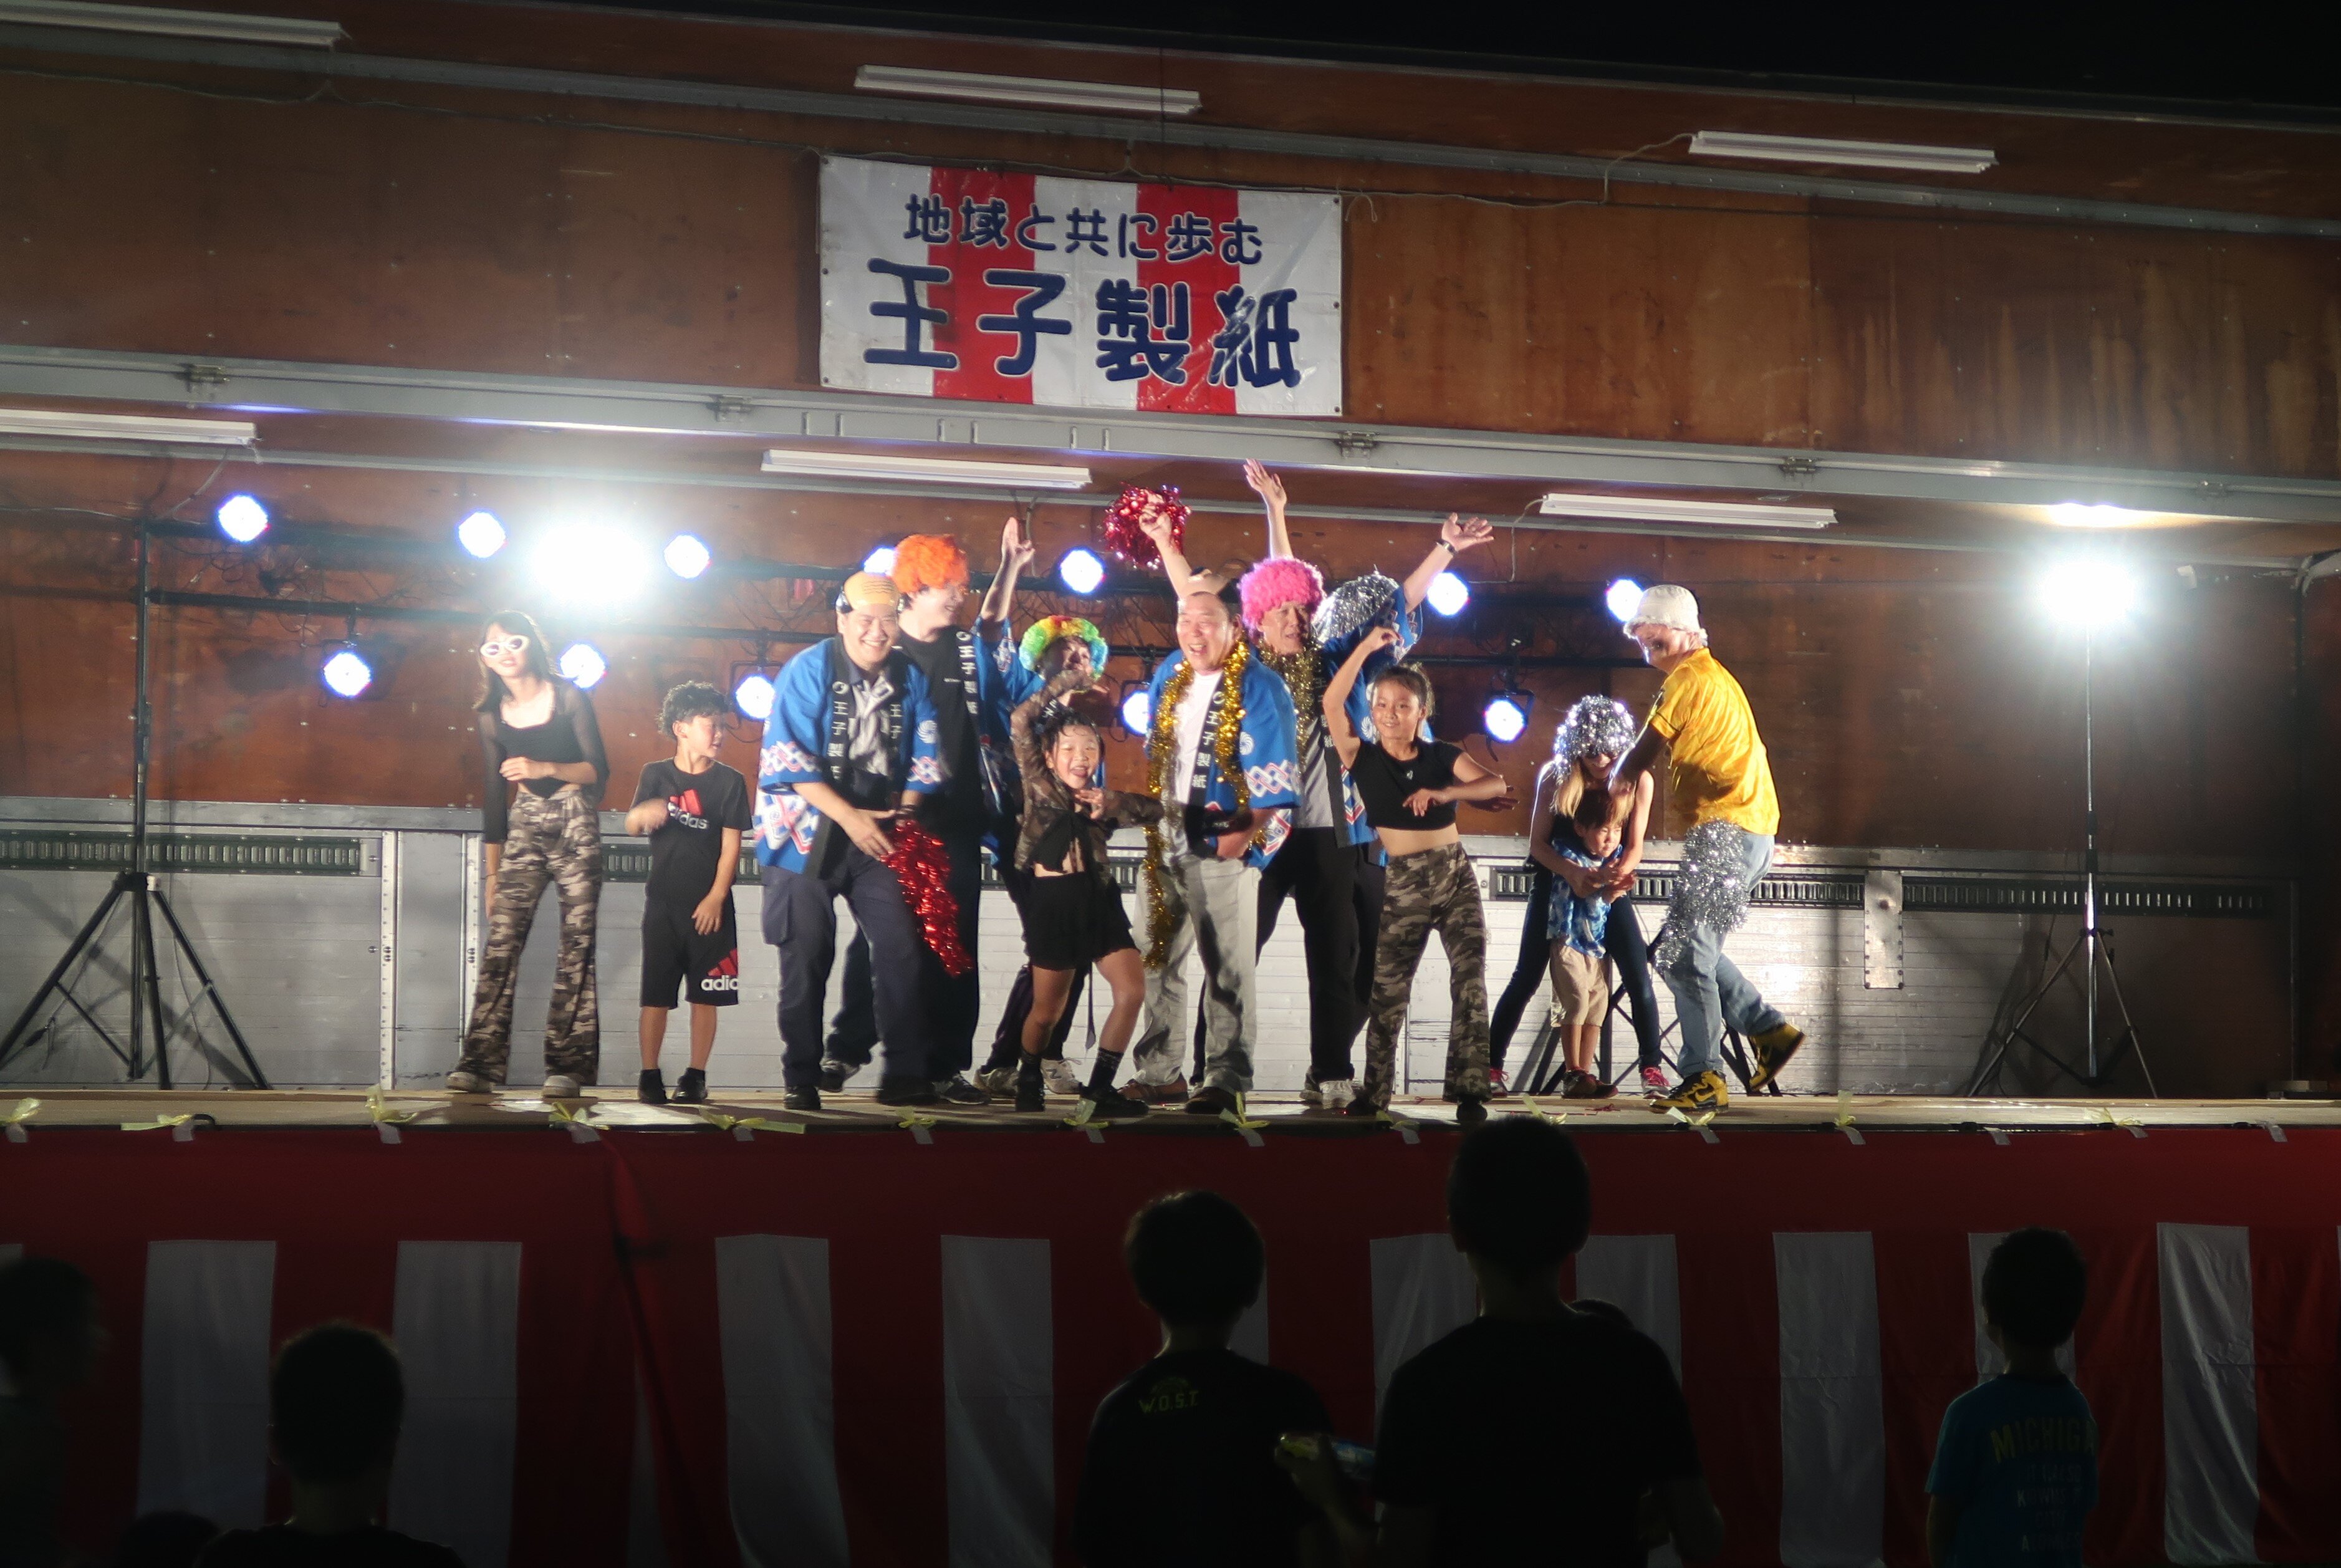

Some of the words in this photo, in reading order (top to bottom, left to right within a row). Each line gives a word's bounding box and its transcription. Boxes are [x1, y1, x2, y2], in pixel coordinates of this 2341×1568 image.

[903, 193, 1262, 265] 地域と共に歩む
[863, 257, 1301, 389] 王子製紙
